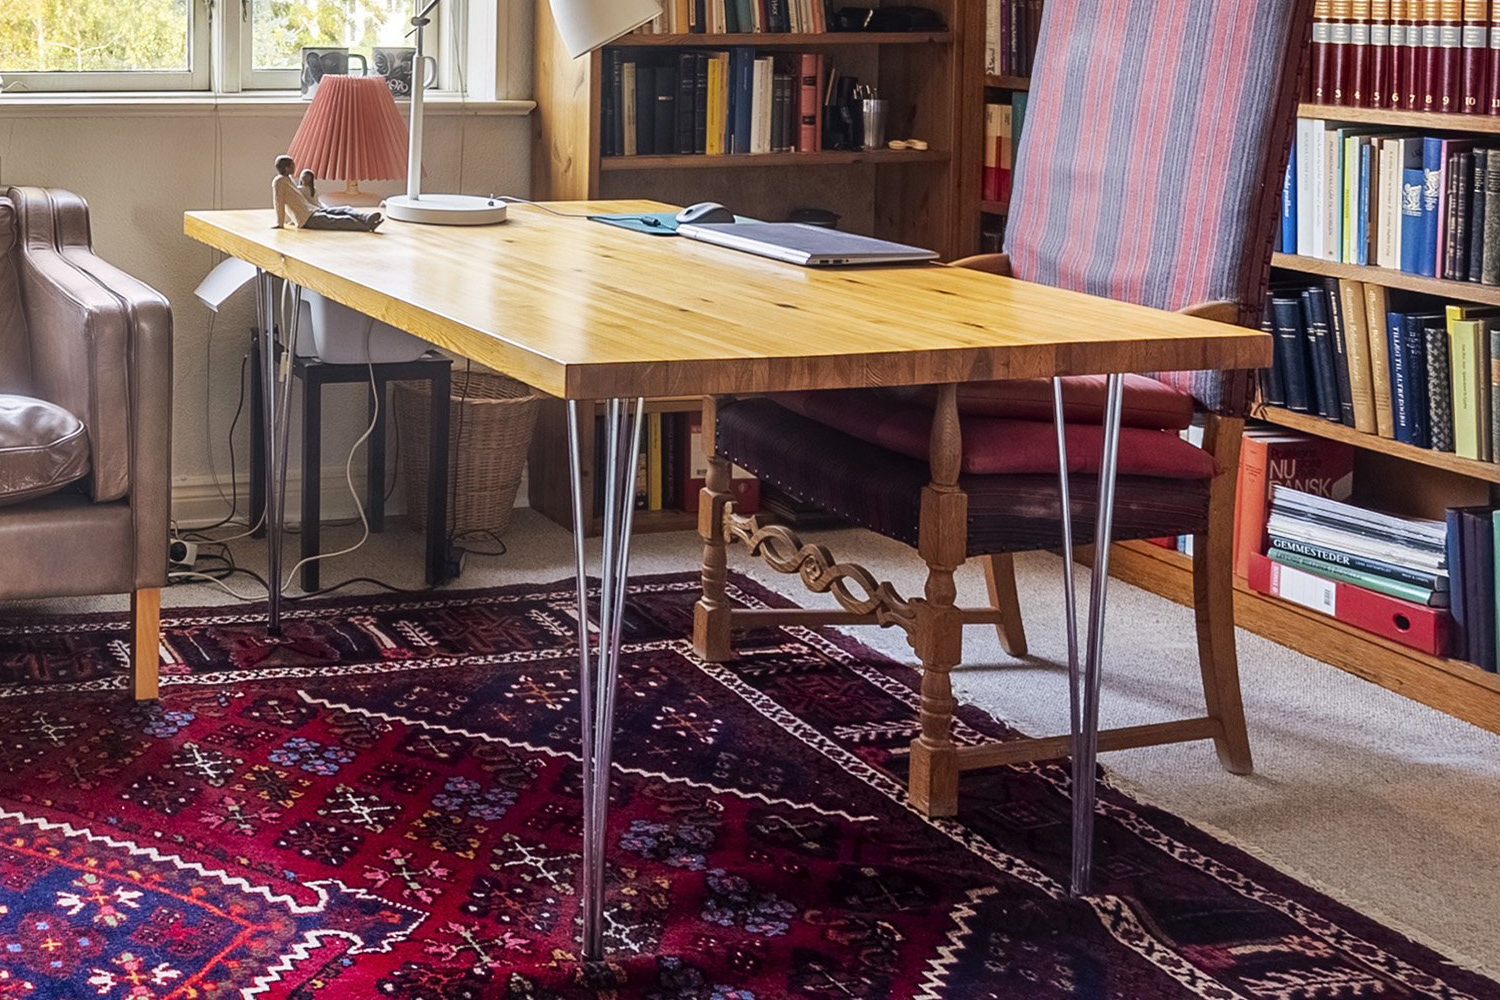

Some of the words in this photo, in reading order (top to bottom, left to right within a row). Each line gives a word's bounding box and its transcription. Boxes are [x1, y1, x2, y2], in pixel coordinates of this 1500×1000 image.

[1316, 88, 1323, 96] 2
[1335, 90, 1342, 98] 3
[1354, 91, 1360, 99] 4
[1374, 92, 1380, 101] 5
[1392, 93, 1399, 102] 6
[1409, 94, 1416, 103] 7
[1425, 95, 1432, 103] 8
[1442, 97, 1449, 105] 9
[1465, 97, 1476, 106] 10
[1269, 459, 1296, 479] NU
[1273, 538, 1351, 566] GEMMESTEDER
